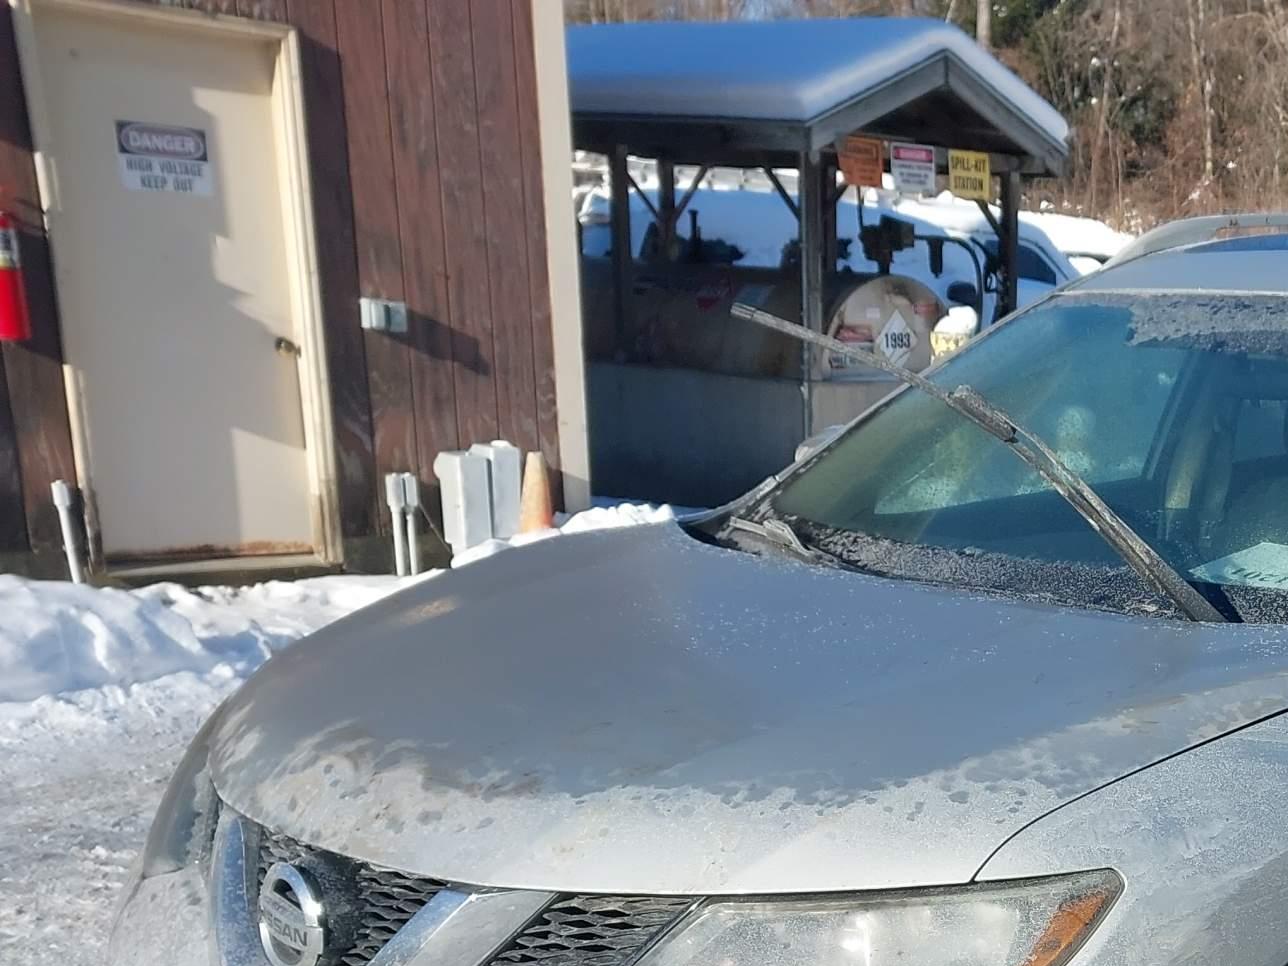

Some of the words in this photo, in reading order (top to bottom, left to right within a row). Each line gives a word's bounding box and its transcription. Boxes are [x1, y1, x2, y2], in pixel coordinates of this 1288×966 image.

[128, 130, 195, 152] DANGER
[126, 157, 153, 172] HIGH
[159, 160, 203, 177] VOLTAGE
[951, 155, 986, 172] SPILL-KIT
[140, 174, 167, 190] KEEP
[172, 178, 194, 192] OUT
[953, 175, 984, 191] STATION
[884, 332, 911, 349] 1993
